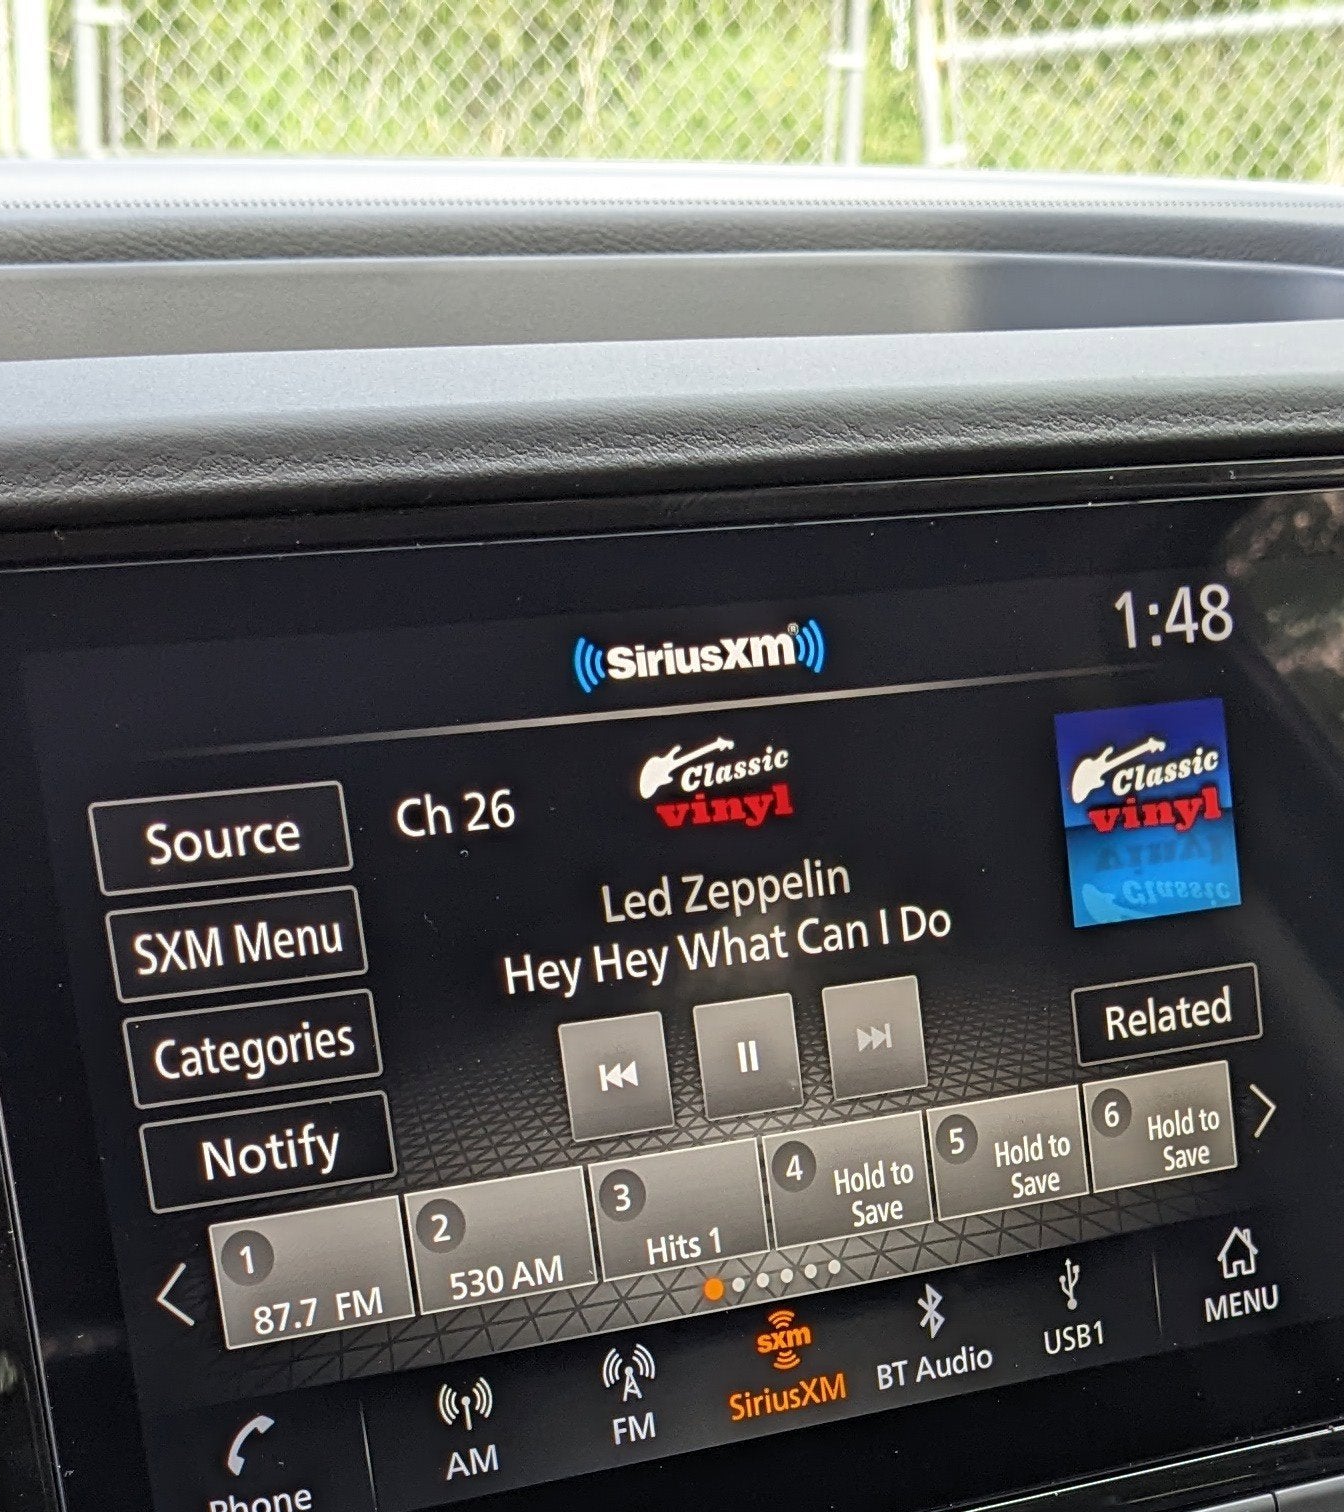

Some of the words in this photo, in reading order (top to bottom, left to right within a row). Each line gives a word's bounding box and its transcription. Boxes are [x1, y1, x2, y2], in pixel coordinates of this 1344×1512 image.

[1114, 583, 1234, 649] 1:48
[682, 745, 789, 794] Classic
[1112, 747, 1220, 797] Classic
[396, 793, 453, 838] Ch
[464, 788, 516, 834] 26
[657, 784, 794, 830] vinyl
[1088, 787, 1222, 834] vinyl
[146, 818, 300, 866] Source
[603, 878, 672, 924] Led
[683, 859, 851, 920] Zeppelin
[134, 928, 224, 977] SXM
[234, 918, 344, 969] Menu
[504, 955, 581, 997] Hey
[594, 940, 669, 986] Hey
[678, 922, 789, 972] What
[798, 916, 869, 954] Can
[880, 910, 890, 944] I
[902, 904, 951, 940] Do
[1105, 986, 1232, 1041] Related
[156, 1022, 355, 1082] Categories
[1104, 1101, 1120, 1128] 6
[1147, 1110, 1196, 1142] Hold
[1199, 1108, 1220, 1131] to
[201, 1124, 340, 1182] Notify
[949, 1128, 964, 1155] 5
[995, 1136, 1045, 1169] Hold
[1048, 1134, 1071, 1157] to
[1163, 1142, 1210, 1171] Save
[785, 1155, 803, 1182] 4
[834, 1162, 887, 1196] Hold
[890, 1160, 914, 1186] to
[1012, 1169, 1060, 1200] Save
[613, 1184, 631, 1212] 3
[851, 1199, 904, 1229] Save
[431, 1214, 451, 1243] 2
[646, 1233, 701, 1266] Hits
[710, 1228, 723, 1254] 1
[240, 1245, 254, 1275] 1
[450, 1265, 504, 1301] 530
[511, 1255, 564, 1290] AM
[255, 1297, 318, 1335] 87.7
[336, 1287, 383, 1321] FM
[1205, 1284, 1280, 1322] MENU
[757, 1324, 812, 1353] sxm
[1044, 1320, 1105, 1355] USB1
[877, 1362, 909, 1391] BT
[916, 1346, 993, 1384] Audio
[729, 1373, 846, 1422] SiriusXM
[612, 1411, 657, 1445] FM
[446, 1444, 499, 1480] AM
